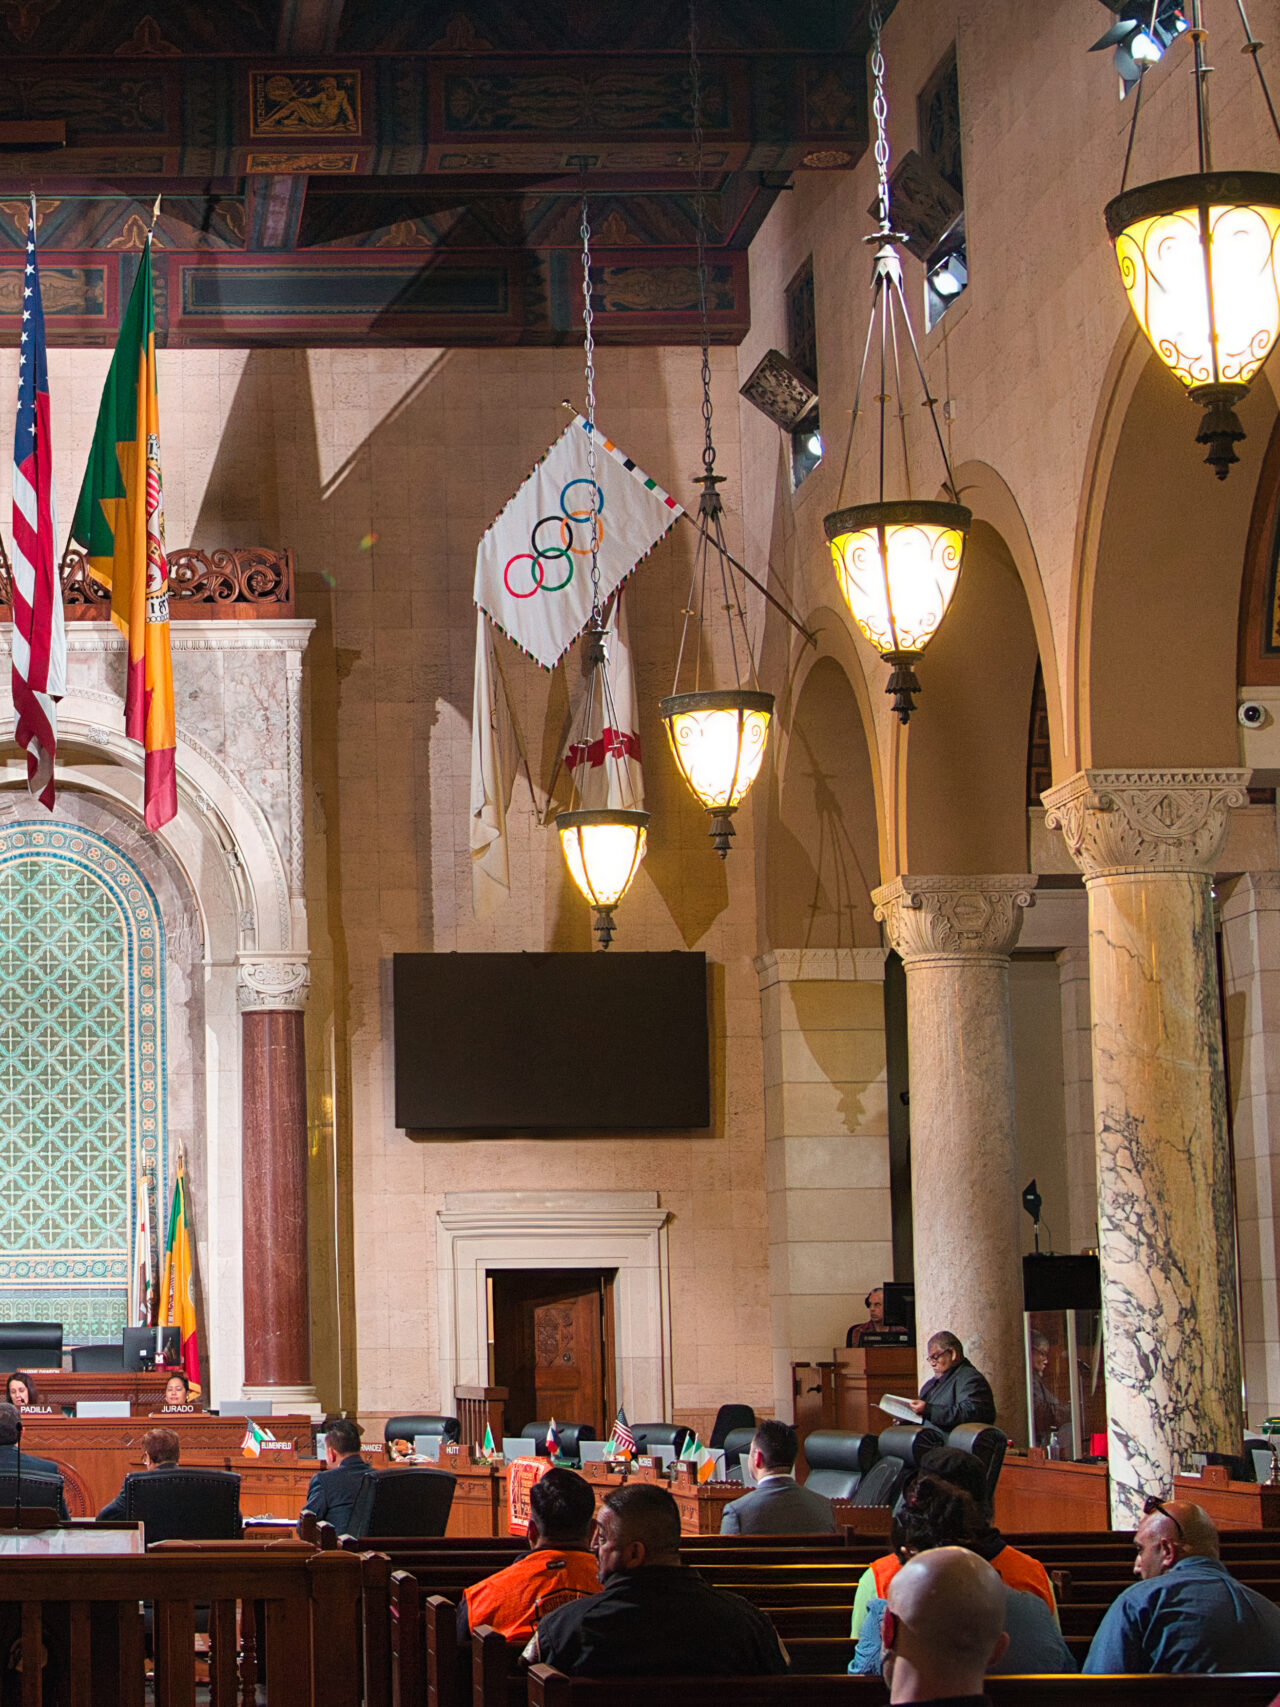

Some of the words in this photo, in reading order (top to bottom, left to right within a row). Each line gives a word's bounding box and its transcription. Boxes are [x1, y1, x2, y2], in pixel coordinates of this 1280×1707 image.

[20, 1406, 52, 1414] PADILLA
[161, 1405, 194, 1413] JURADO
[261, 1441, 292, 1450] BLUMENFIELD
[446, 1446, 460, 1455] HUTT
